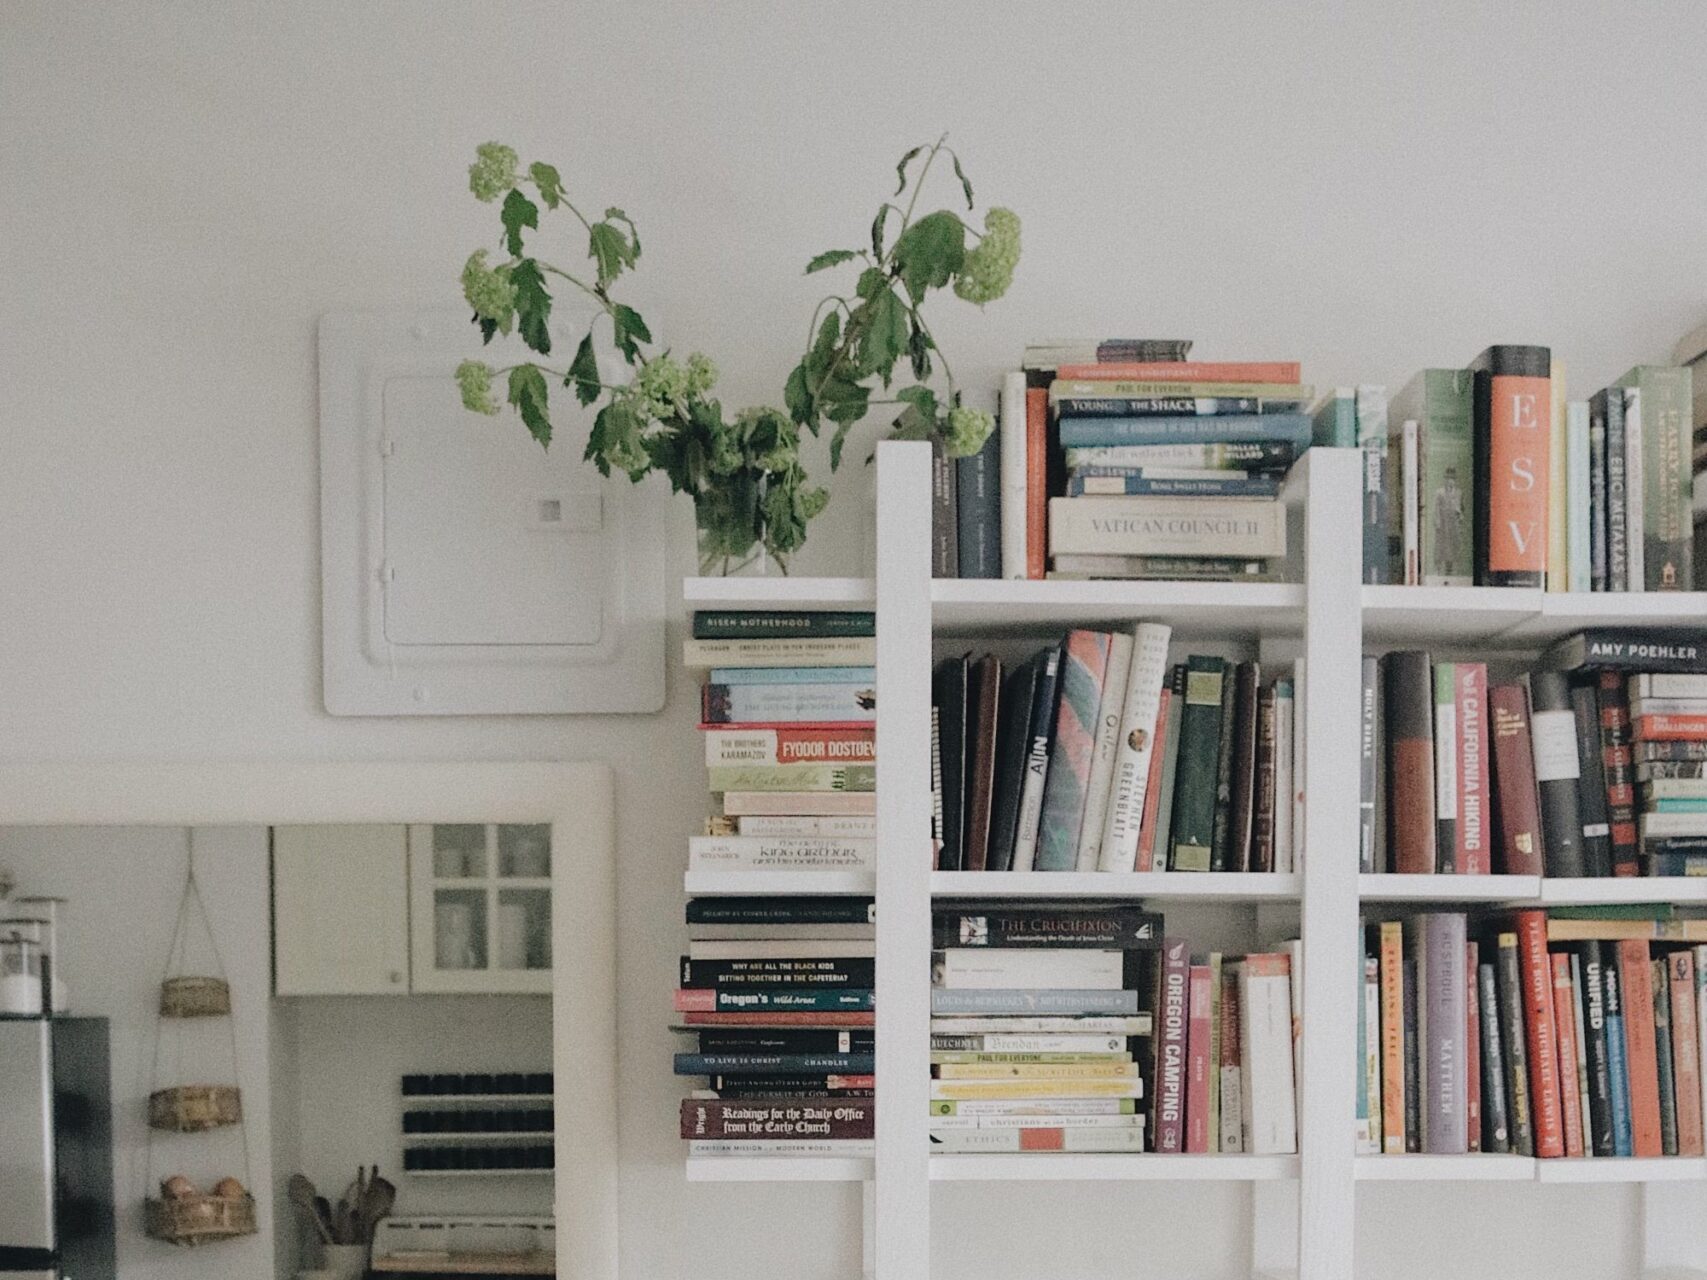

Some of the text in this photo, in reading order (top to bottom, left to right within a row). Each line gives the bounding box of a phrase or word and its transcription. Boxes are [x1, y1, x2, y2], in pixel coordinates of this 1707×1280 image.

[1072, 399, 1195, 411] YOUNG THE SHACK
[1610, 405, 1621, 444] MEN
[1611, 457, 1623, 492] ERIC
[1091, 519, 1258, 534] VATICAN COUNCIL II
[1612, 501, 1624, 573] METAXAS
[707, 618, 811, 626] RISEN MOTHERHOOD
[1590, 643, 1698, 659] AMY POEHLER
[1363, 689, 1374, 758] HOLY BIBLE
[721, 739, 766, 748] THE BROTHERS
[783, 741, 825, 757] FYODOR
[721, 751, 766, 759] KARAMAZOV
[1463, 699, 1480, 850] CALIFORNIA HIKING
[1113, 762, 1134, 840] GREENBLATT
[1129, 775, 1145, 831] STEPHEN
[1001, 918, 1122, 931] THE CRUCIFIXION
[1529, 921, 1544, 1002] FLASH BOYS
[719, 974, 848, 982] SITTING TOGETHER IN THE CAFETERIA?
[720, 993, 769, 1006] Oregon's
[1587, 963, 1603, 1030] UNIFIED
[1163, 974, 1183, 1121] OREGON CAMPING
[1441, 1038, 1453, 1114] MATTHEW
[1538, 1022, 1554, 1131] MICHAEL LEWIS
[808, 1090, 829, 1098] GOD
[722, 1106, 865, 1121] Readings for the Daily Office
[723, 1120, 831, 1135] from the Early Church
